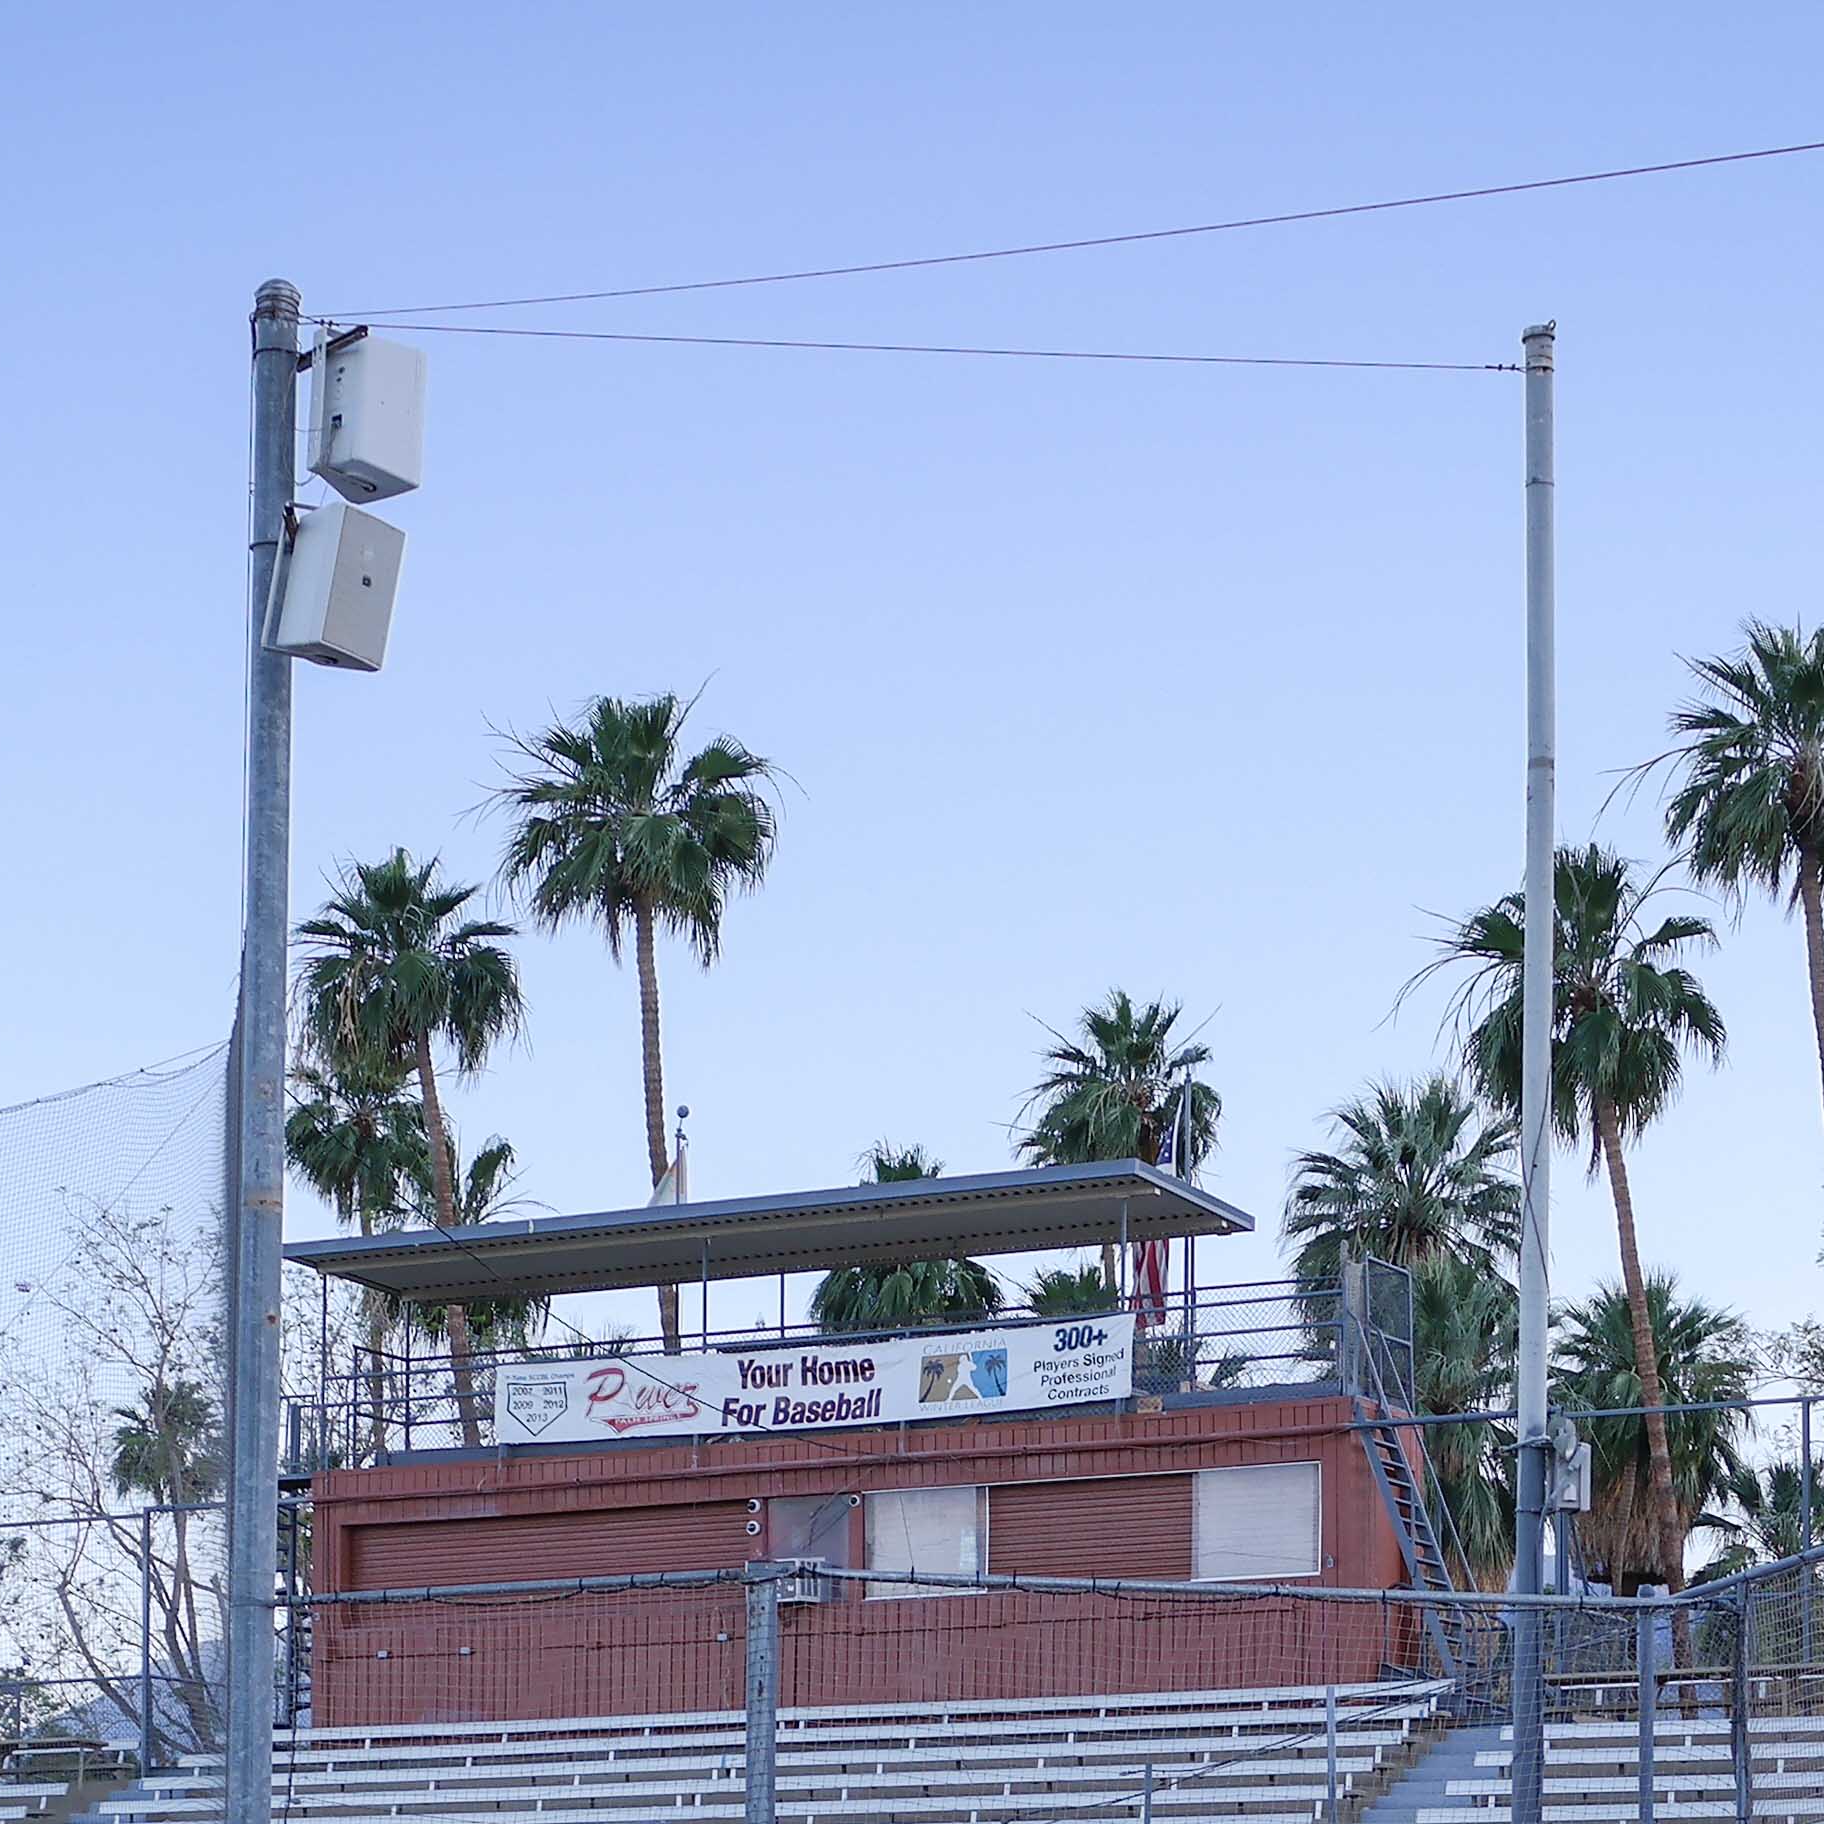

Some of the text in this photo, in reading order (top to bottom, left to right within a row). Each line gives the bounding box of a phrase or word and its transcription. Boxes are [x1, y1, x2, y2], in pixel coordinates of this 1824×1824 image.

[923, 1339, 1006, 1354] CALIFORNIA
[1053, 1325, 1108, 1352] 300+
[1033, 1347, 1124, 1373] Players Signed
[737, 1355, 875, 1389] Your Home
[1041, 1365, 1116, 1386] Professional
[512, 1386, 562, 1396] 2007 2011
[1048, 1384, 1110, 1400] Contracts
[512, 1399, 564, 1410] 2009 2012
[722, 1388, 882, 1427] For Baseball
[919, 1399, 1002, 1412] WINTER LEAGUE
[526, 1413, 548, 1423] 2013
